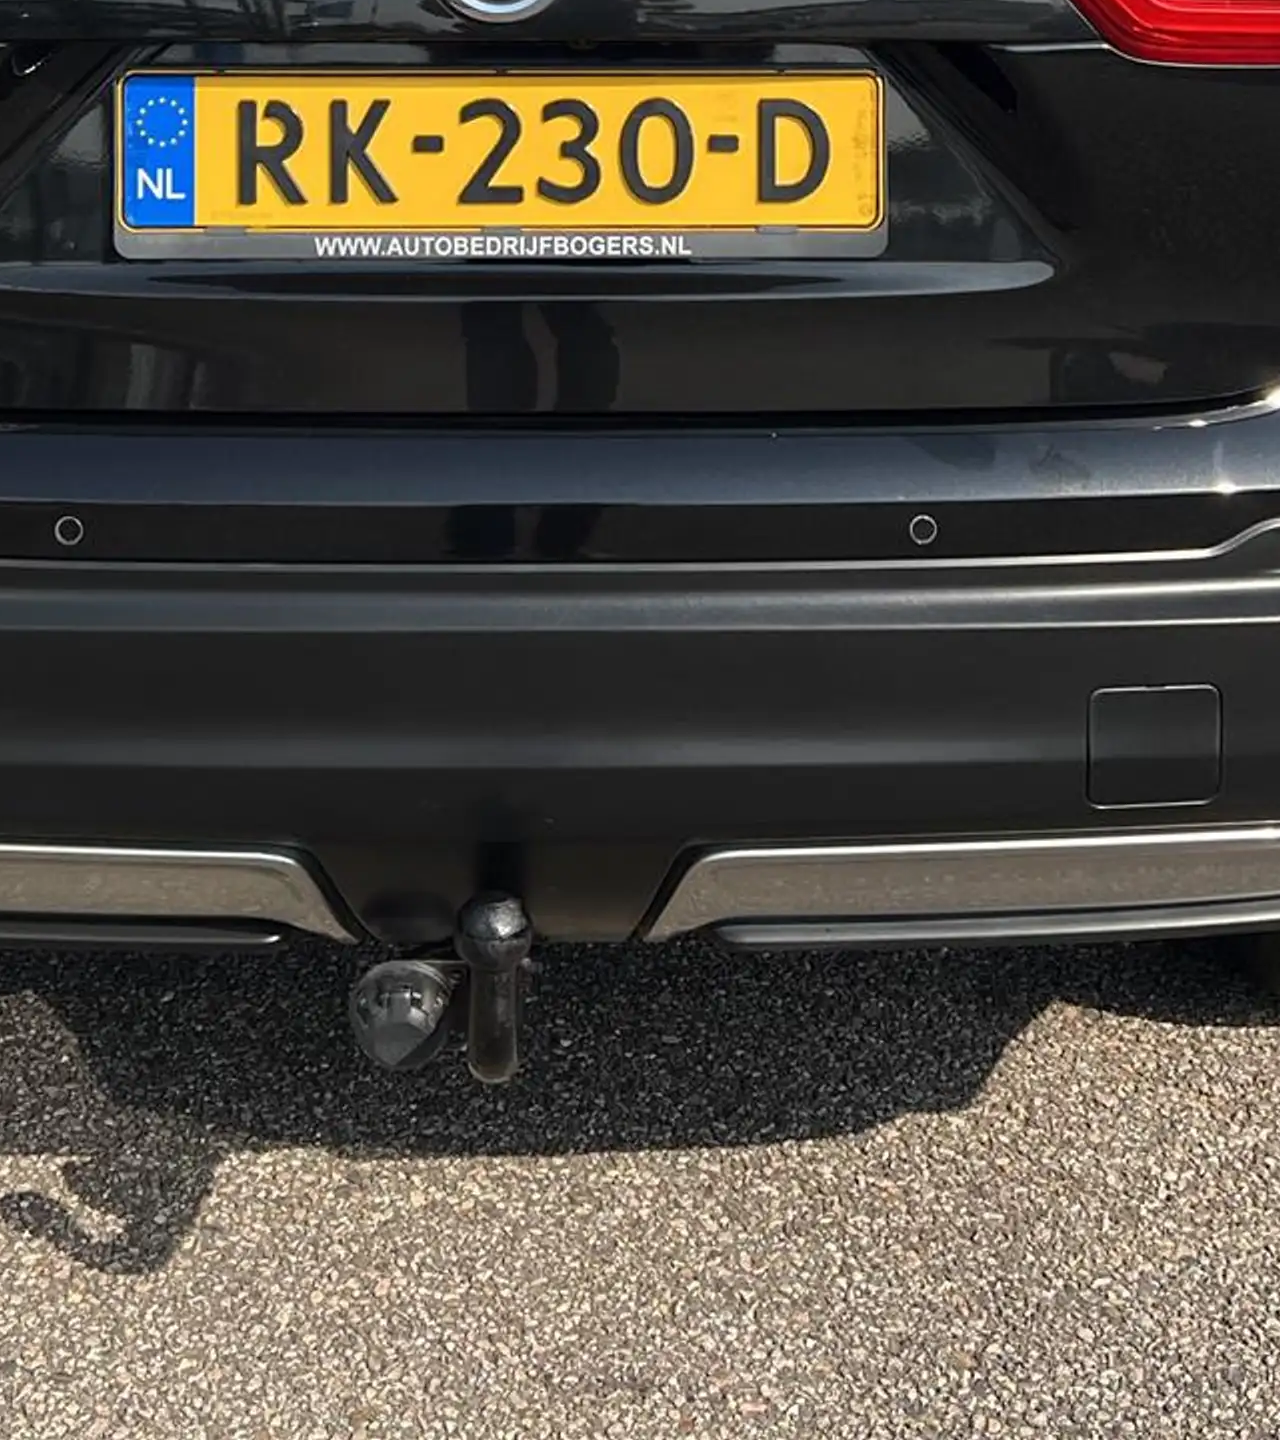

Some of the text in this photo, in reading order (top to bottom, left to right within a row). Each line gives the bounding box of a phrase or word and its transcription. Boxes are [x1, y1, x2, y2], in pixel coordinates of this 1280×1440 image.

[137, 168, 186, 200] NL
[236, 97, 830, 205] RK-230-D
[314, 236, 693, 257] WWW.AUTOBEDRIJFBOGERS.NL
